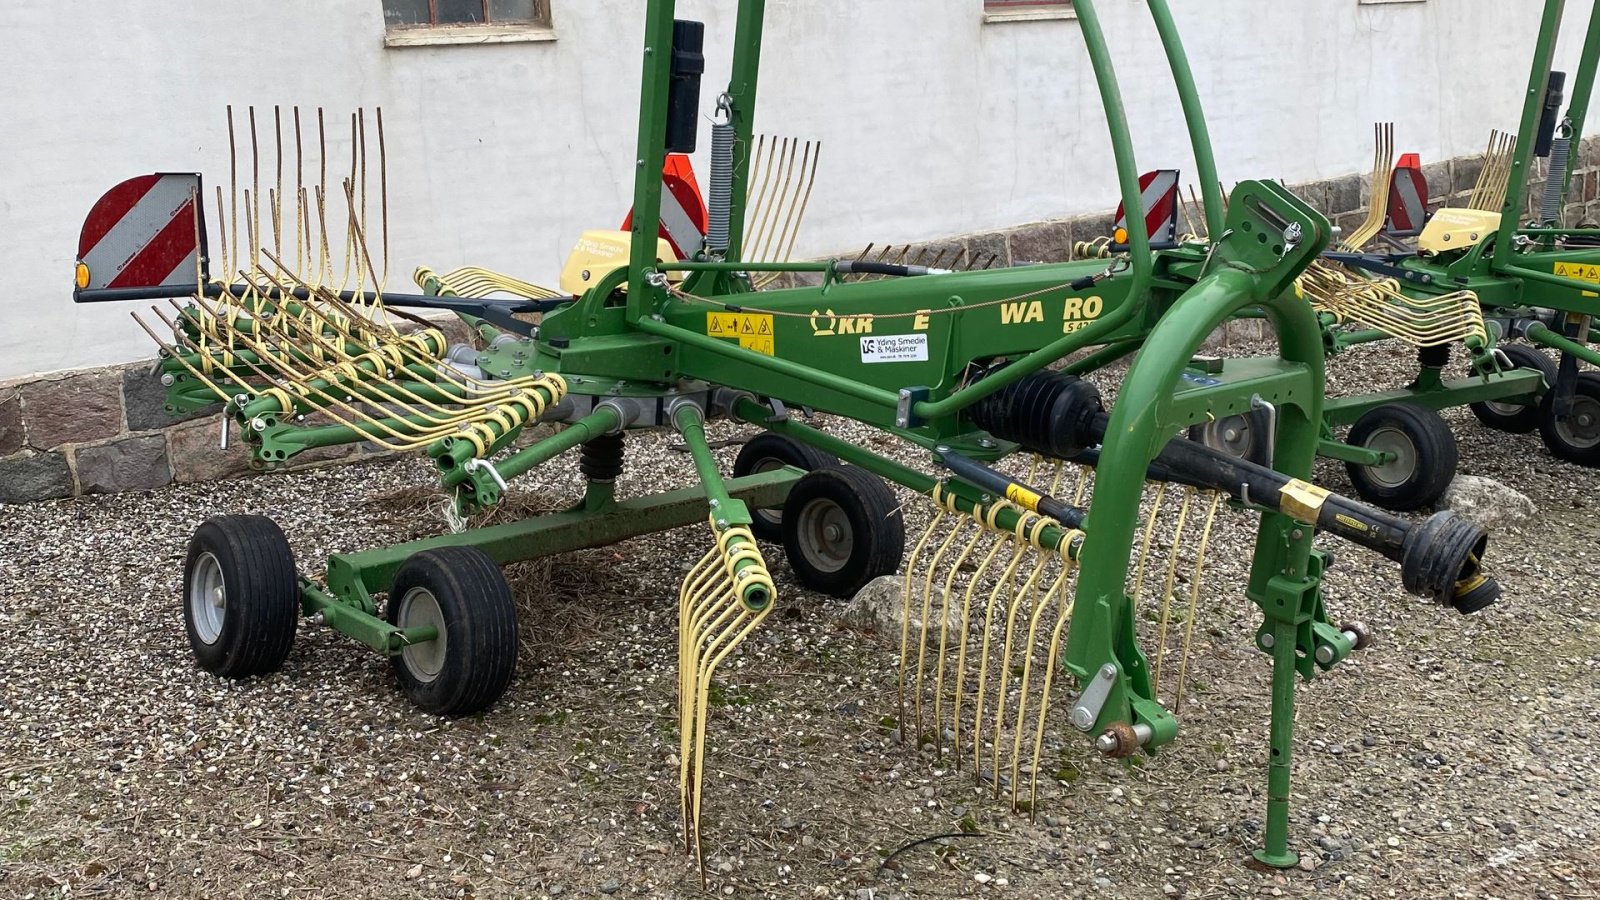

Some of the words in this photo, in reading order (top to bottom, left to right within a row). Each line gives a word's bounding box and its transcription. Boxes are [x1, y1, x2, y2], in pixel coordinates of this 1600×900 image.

[1067, 322, 1074, 332] S
[876, 339, 897, 347] Yding
[898, 337, 925, 346] Smedie
[878, 346, 884, 354] &
[885, 345, 917, 353] Maskiner
